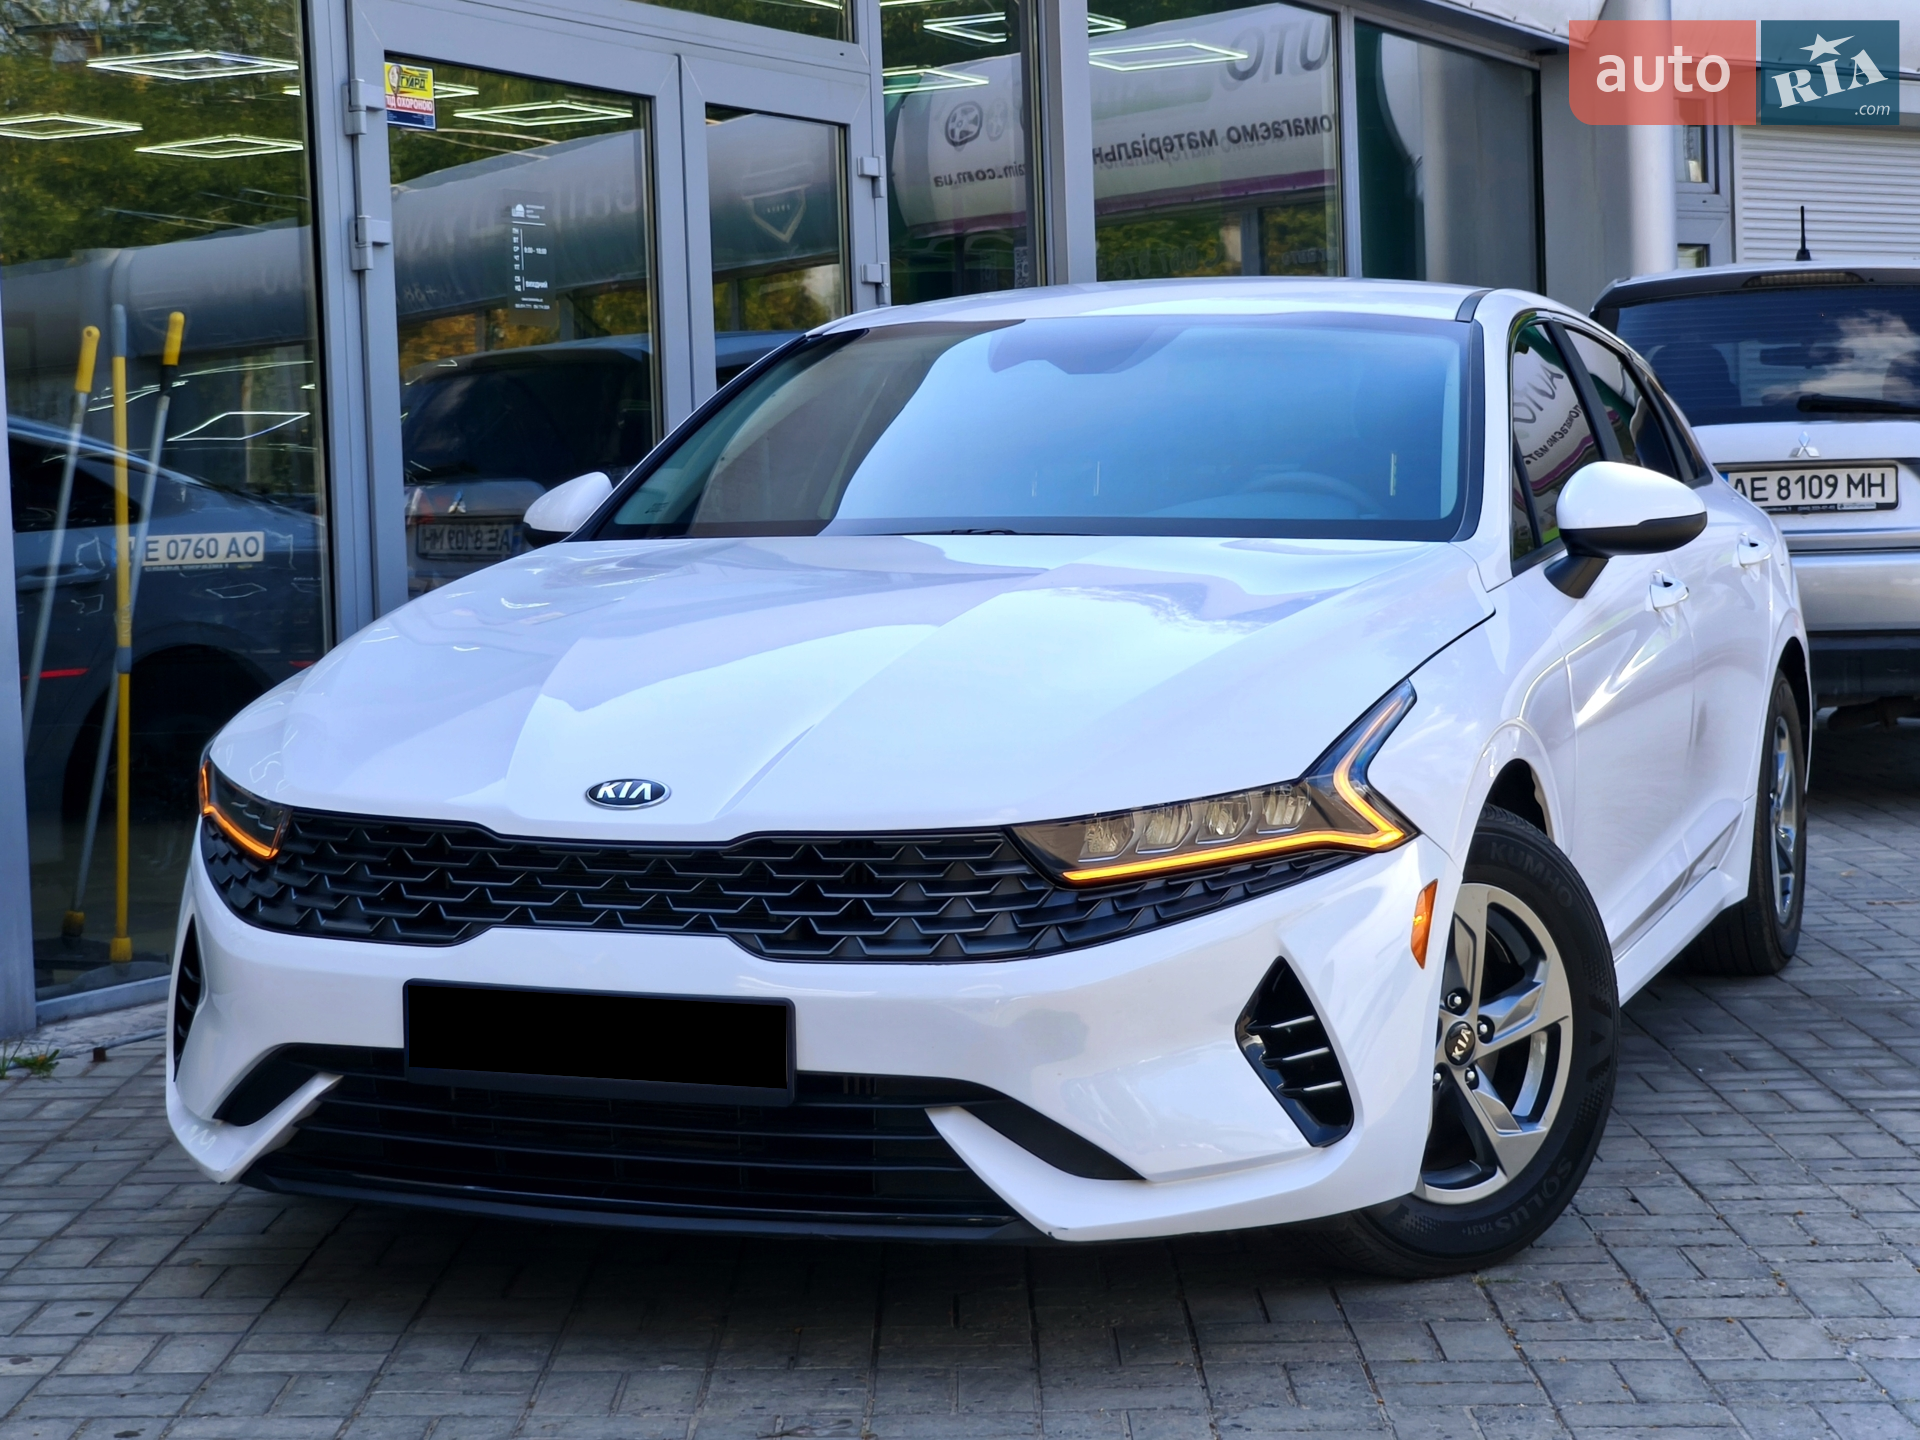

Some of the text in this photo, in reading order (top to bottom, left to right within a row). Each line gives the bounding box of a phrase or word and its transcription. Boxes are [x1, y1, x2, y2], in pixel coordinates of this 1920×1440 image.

[399, 75, 426, 89] ГУАРД
[397, 96, 433, 112] ОХОРОНОЮ
[1733, 472, 1886, 502] AE 8109 MH
[166, 537, 219, 561] 0760
[225, 535, 260, 559] AO
[597, 781, 652, 801] KIA
[1490, 841, 1573, 908] KUMHO
[1451, 1028, 1471, 1061] KIA
[1494, 1157, 1572, 1233] SOLUS
